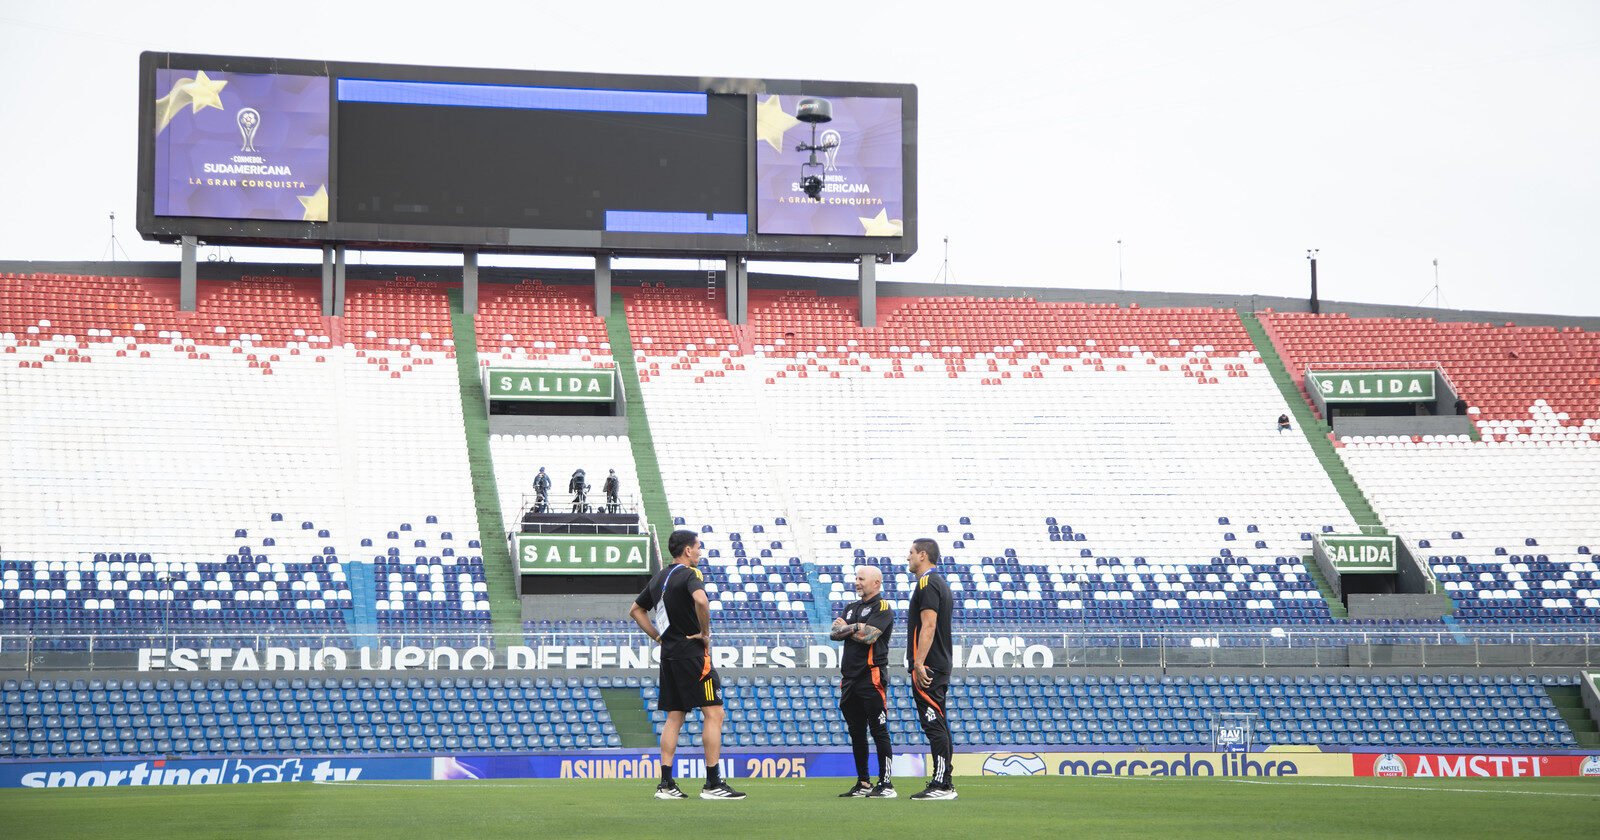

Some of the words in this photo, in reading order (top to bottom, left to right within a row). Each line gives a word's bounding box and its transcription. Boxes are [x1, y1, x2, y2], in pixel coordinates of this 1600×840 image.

[203, 163, 292, 176] SUDAMERICANA
[207, 178, 237, 187] GRAN
[241, 180, 305, 189] CONQUISTA
[791, 182, 870, 193] SUMERICANA
[828, 197, 883, 206] CONQUISTA
[501, 376, 601, 393] SALIDA
[1321, 379, 1423, 394] SALIDA
[524, 545, 643, 563] SALIDA
[1326, 545, 1391, 563] SALIDA
[138, 646, 347, 672] ESTADIO
[507, 645, 796, 669] DEFENRES
[311, 760, 363, 782] tv
[747, 758, 806, 779] 2025
[1058, 753, 1215, 777] mercado
[1221, 753, 1299, 777] libre
